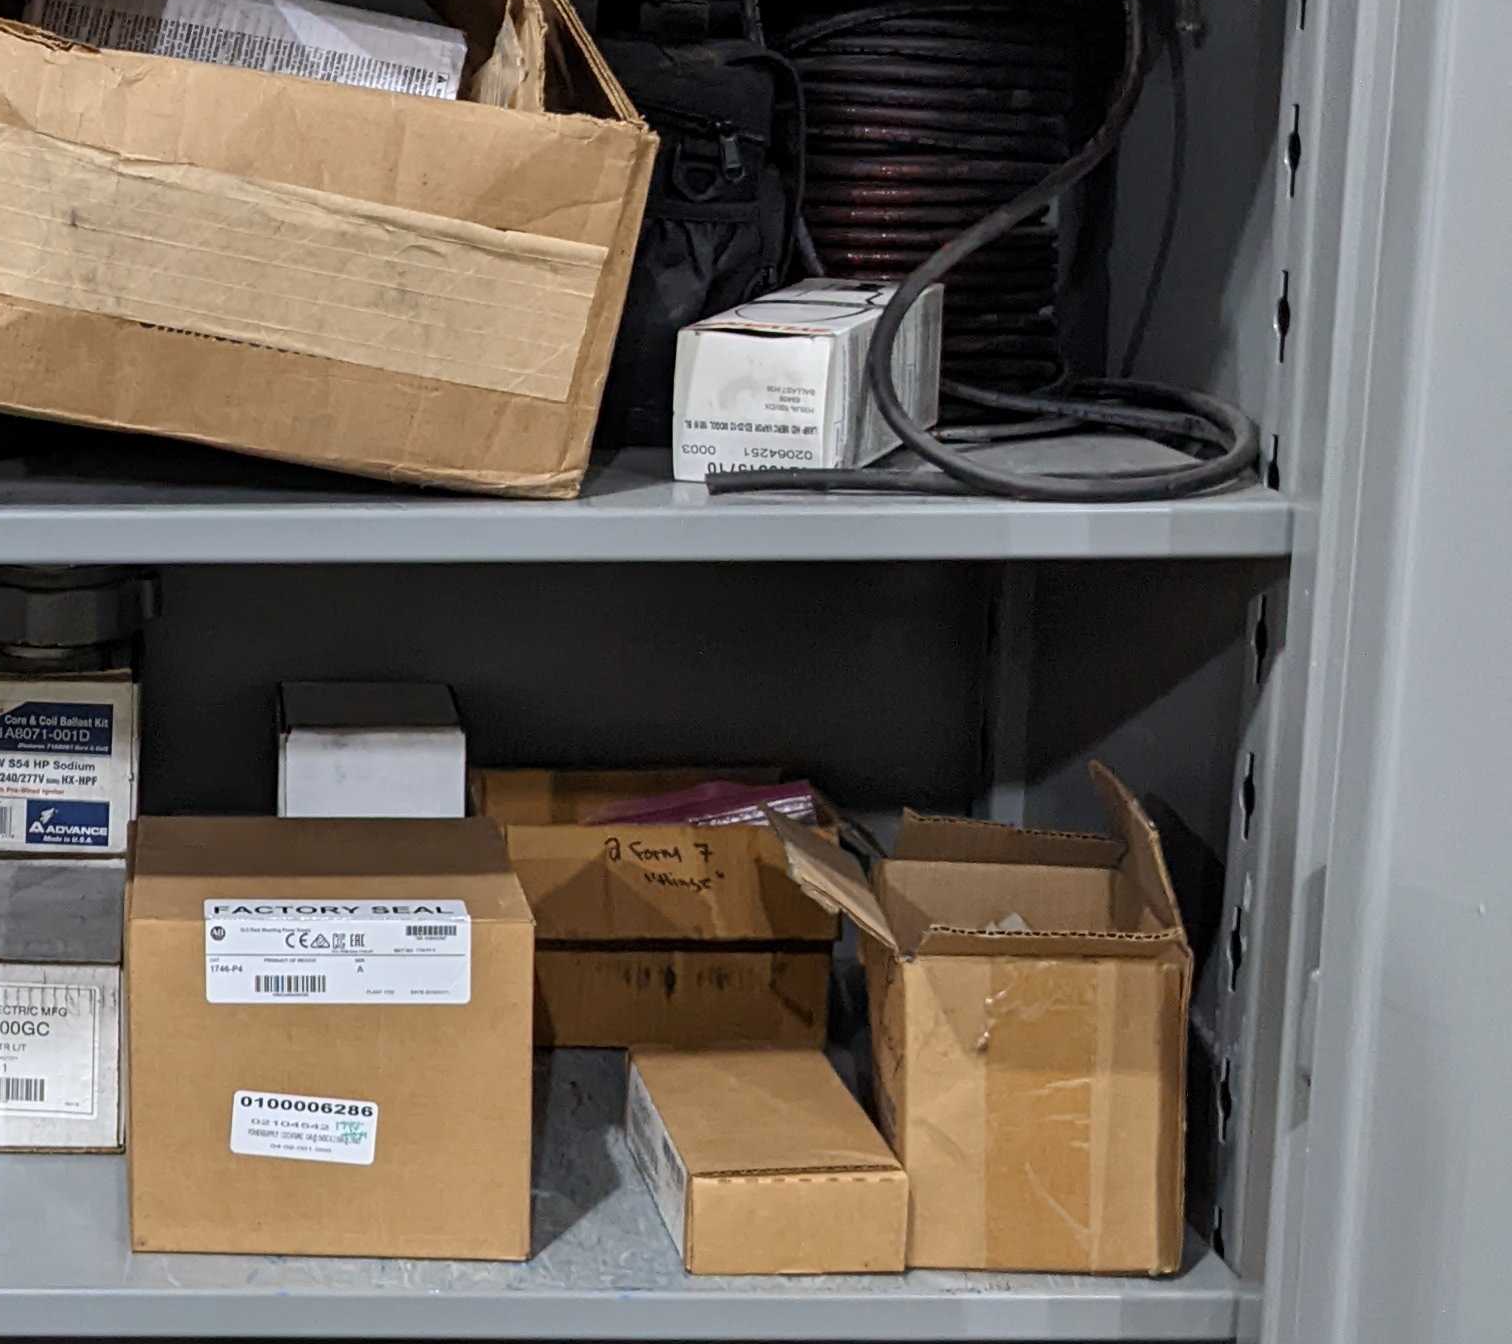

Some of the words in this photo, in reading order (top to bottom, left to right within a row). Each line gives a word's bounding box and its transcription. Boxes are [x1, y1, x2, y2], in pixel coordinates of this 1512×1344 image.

[683, 444, 716, 455] 0003
[744, 447, 813, 460] 02064251
[4, 715, 27, 725] Core
[29, 715, 37, 726] &
[39, 716, 58, 726] Coil
[60, 716, 93, 727] Ballast
[95, 718, 108, 728] Kit
[8, 759, 30, 769] S54
[33, 760, 49, 769] HP
[53, 761, 95, 771] Sodium
[47, 826, 107, 835] ADVANCE
[214, 905, 360, 914] FACTORY
[372, 905, 455, 914] SEAL
[210, 965, 243, 973] 1746-P4
[357, 965, 364, 973] A
[40, 1006, 68, 1018] MFG
[241, 1096, 373, 1117] 0100006286
